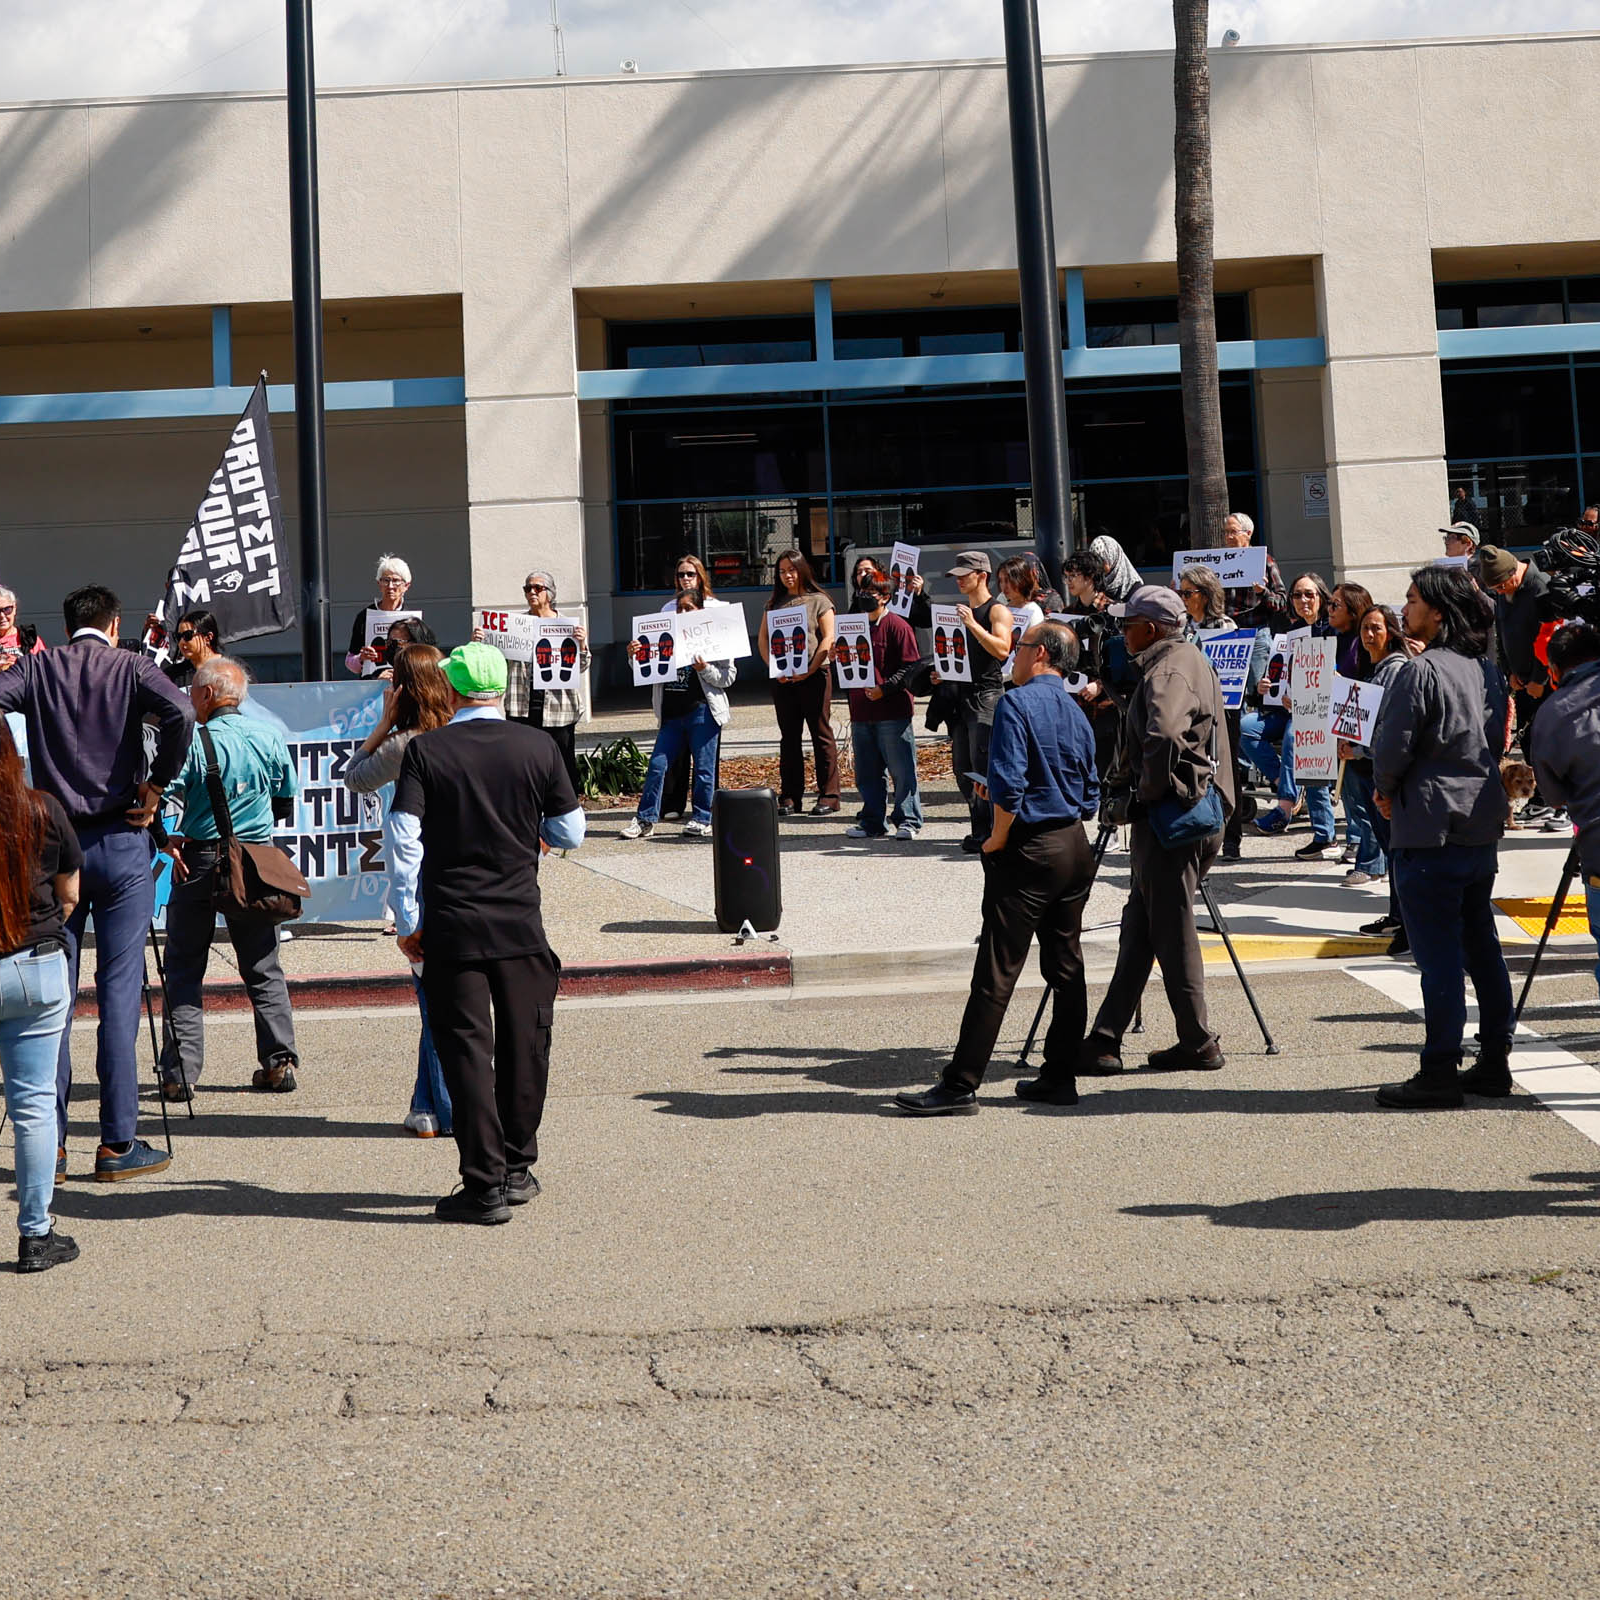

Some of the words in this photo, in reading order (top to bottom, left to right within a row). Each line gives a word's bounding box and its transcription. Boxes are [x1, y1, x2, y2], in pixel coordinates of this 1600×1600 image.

[225, 418, 280, 596] PROTECT
[1183, 553, 1220, 564] Standing
[1224, 552, 1237, 560] for
[1222, 569, 1244, 579] can't
[482, 611, 508, 632] ICE
[641, 622, 668, 631] MISSING
[775, 616, 800, 625] MISSING
[938, 615, 960, 623] MISSING
[683, 620, 713, 640] NOT
[649, 650, 659, 659] OF
[662, 647, 673, 657] 46
[785, 644, 793, 652] OF
[1205, 644, 1250, 659] NIKKEI
[1295, 644, 1325, 669] Abolish
[537, 654, 545, 664] 21
[549, 654, 560, 664] OF
[563, 654, 576, 664] 46
[849, 653, 858, 662] OF
[1211, 658, 1247, 670] SISTERS
[1305, 670, 1320, 688] ICE
[1349, 684, 1361, 702] ICE
[329, 698, 378, 734] 628
[1339, 719, 1357, 735] ZONE
[1295, 730, 1326, 748] DEFEND
[1295, 753, 1332, 775] Democracy
[304, 788, 359, 827] TU
[273, 830, 385, 877] ENTE
[351, 875, 391, 902] 707
